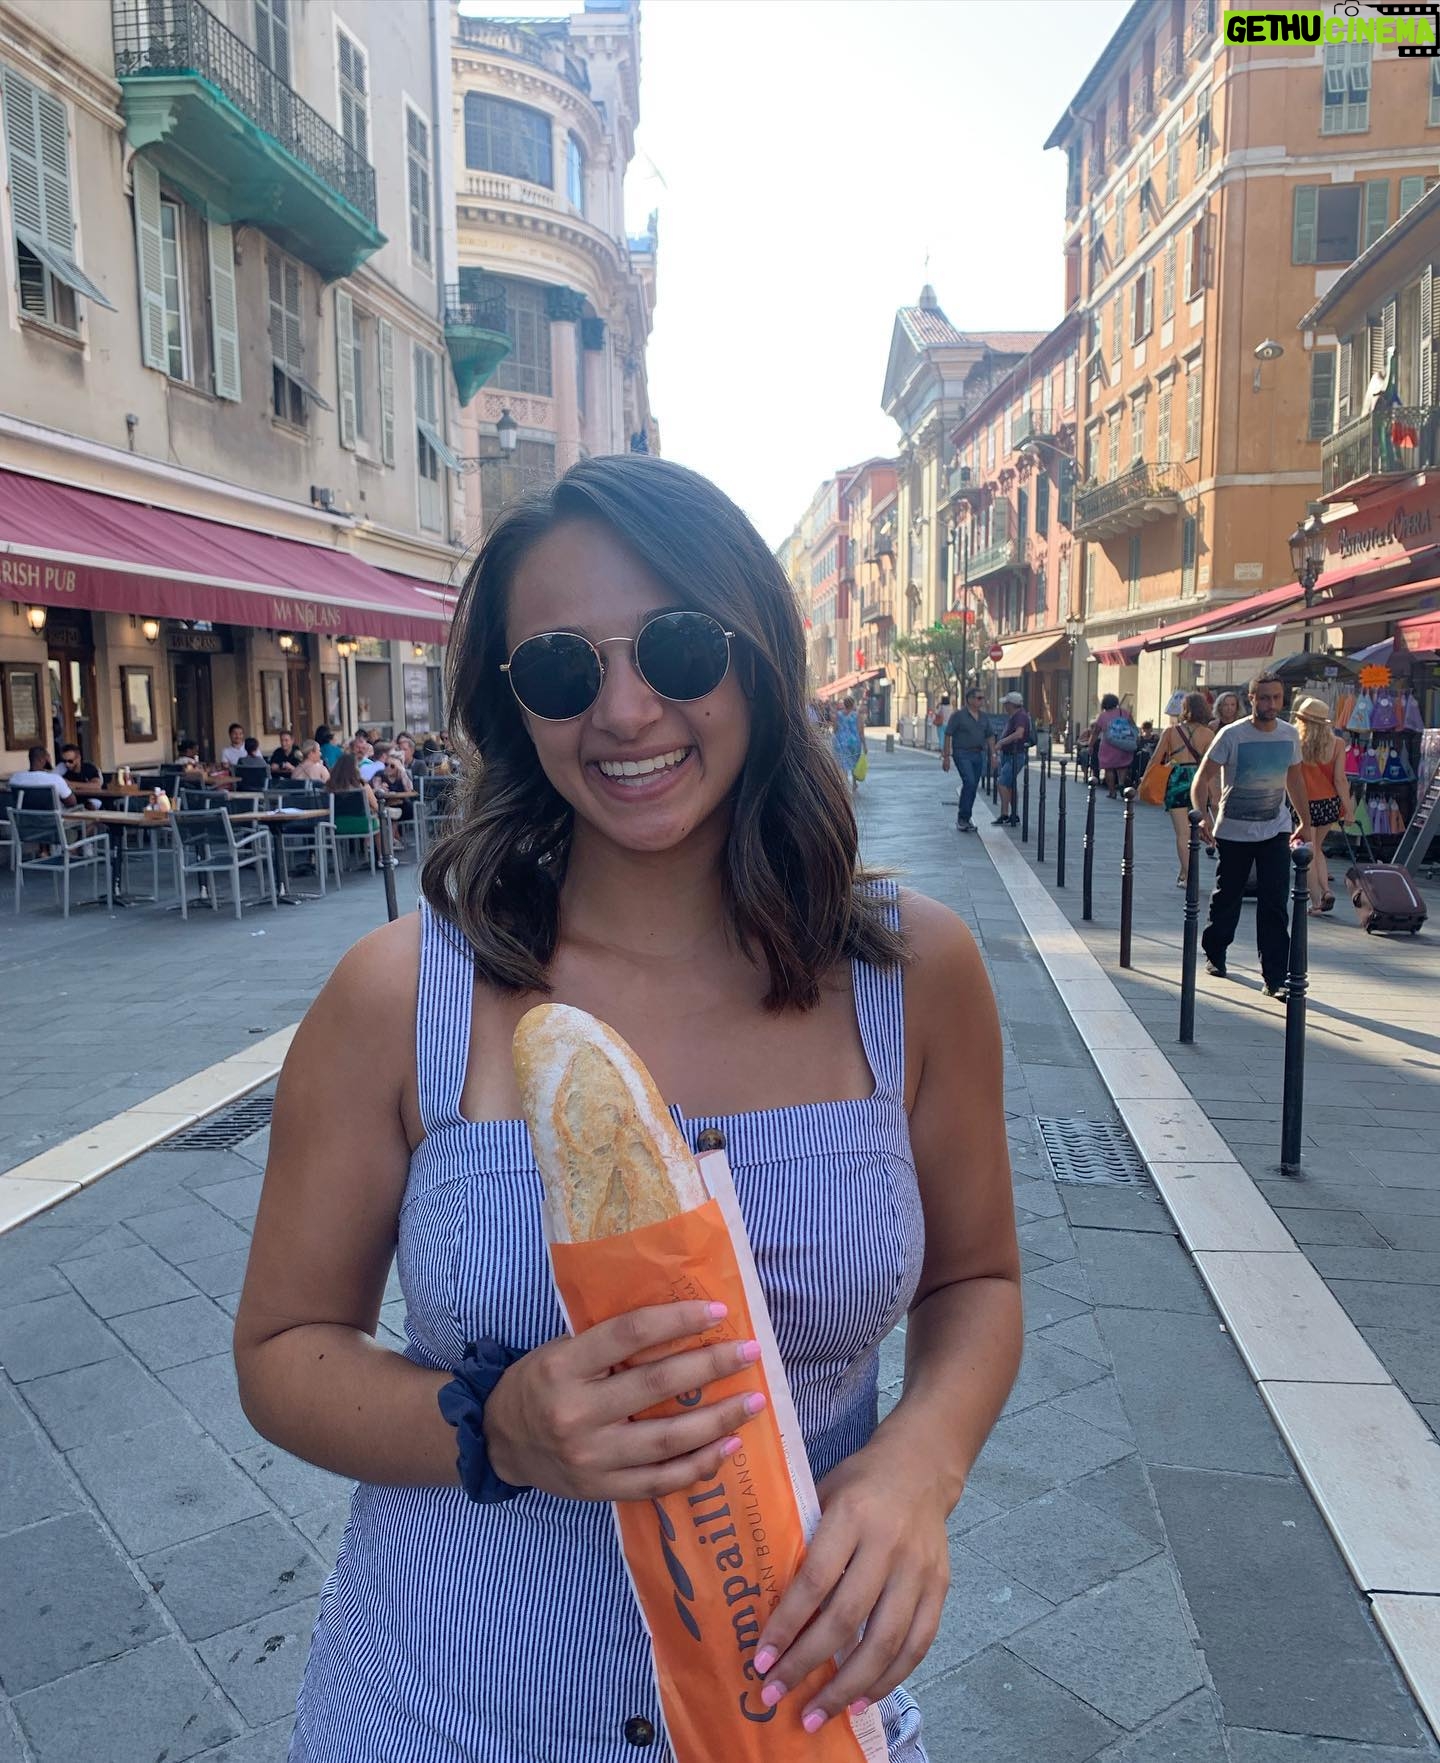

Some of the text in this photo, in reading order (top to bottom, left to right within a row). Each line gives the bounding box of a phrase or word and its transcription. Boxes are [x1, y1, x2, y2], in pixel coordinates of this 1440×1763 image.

[0, 560, 76, 592] RISH PUB
[728, 1432, 770, 1557] BOULANG
